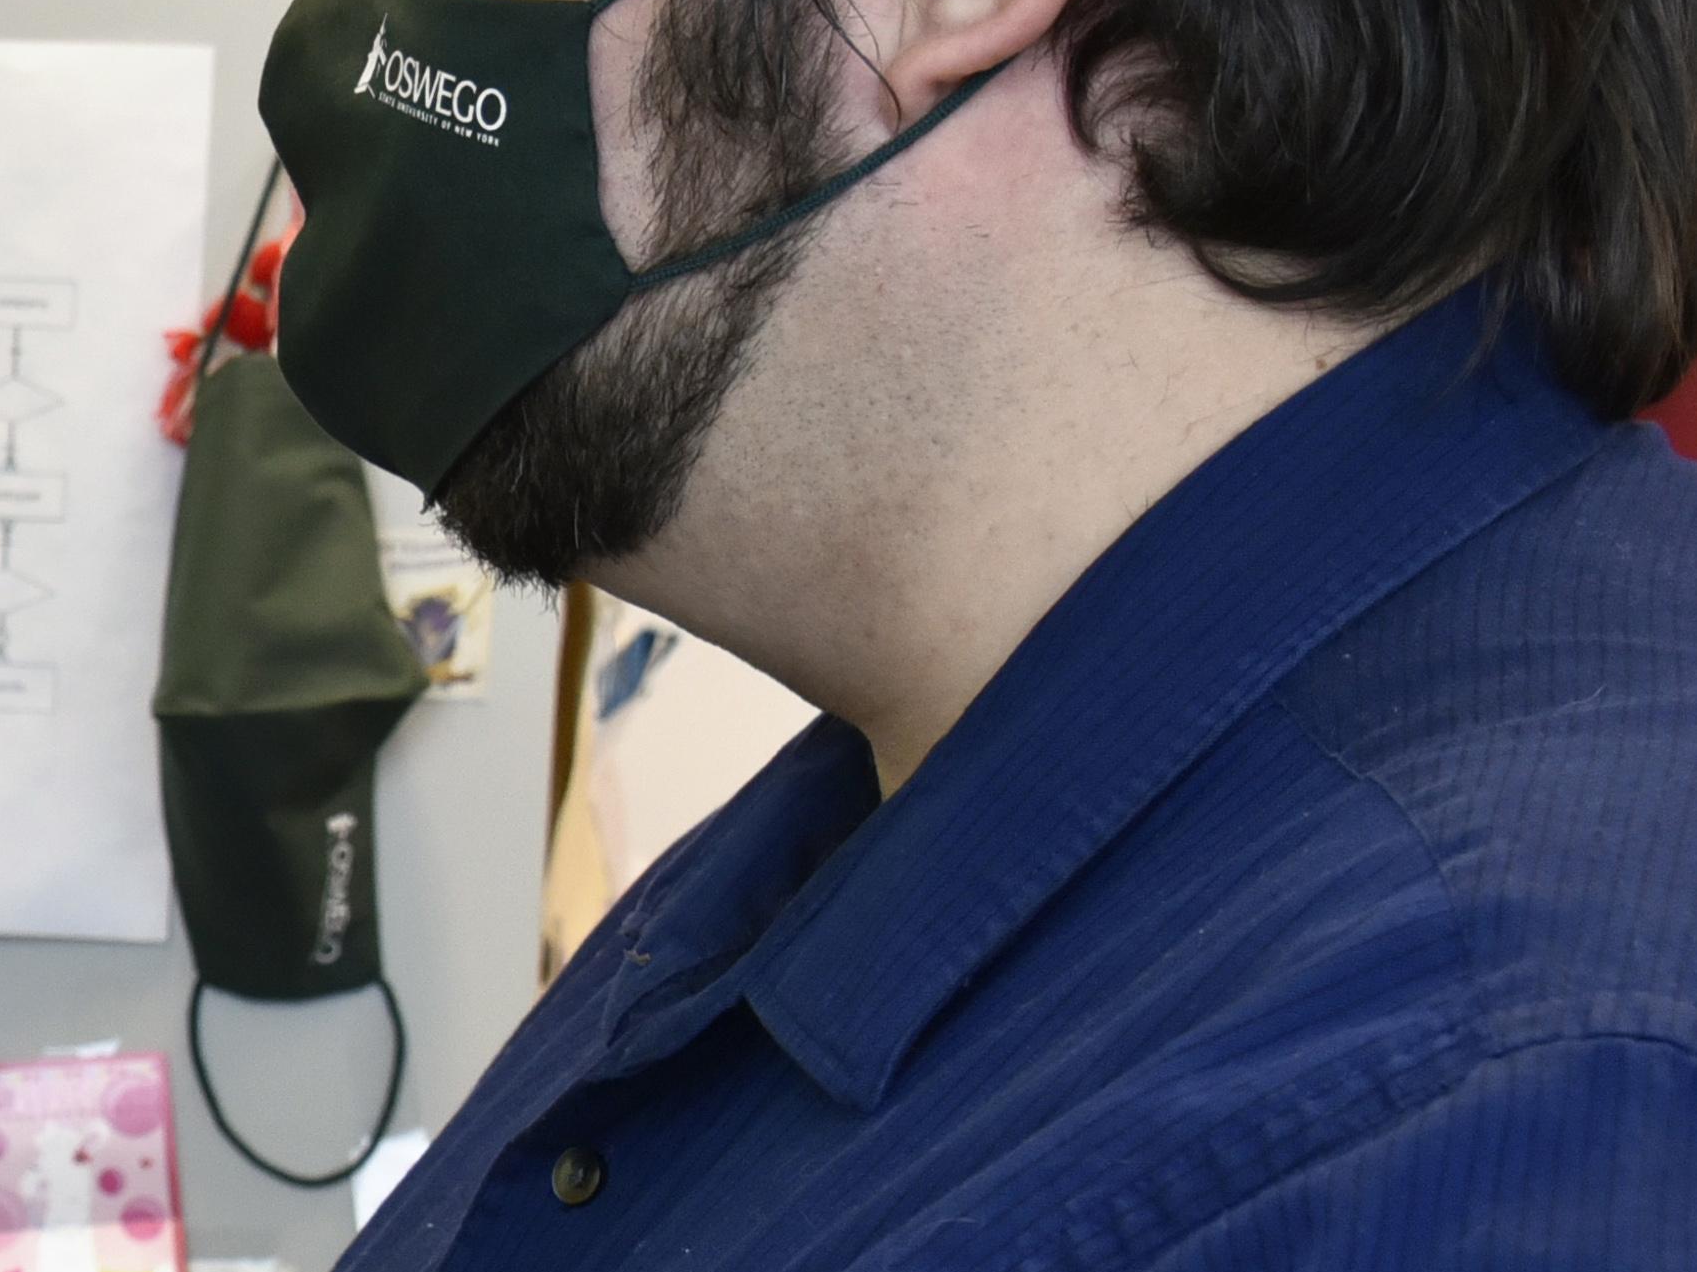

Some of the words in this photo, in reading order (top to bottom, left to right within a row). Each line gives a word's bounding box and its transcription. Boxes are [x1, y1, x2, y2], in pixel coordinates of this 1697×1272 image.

[378, 91, 395, 108] STATE
[397, 100, 439, 126] UNIVERSITY
[441, 120, 451, 131] OF
[455, 125, 473, 138] NEW
[477, 133, 500, 148] YORK
[385, 50, 507, 131] OSWEGO
